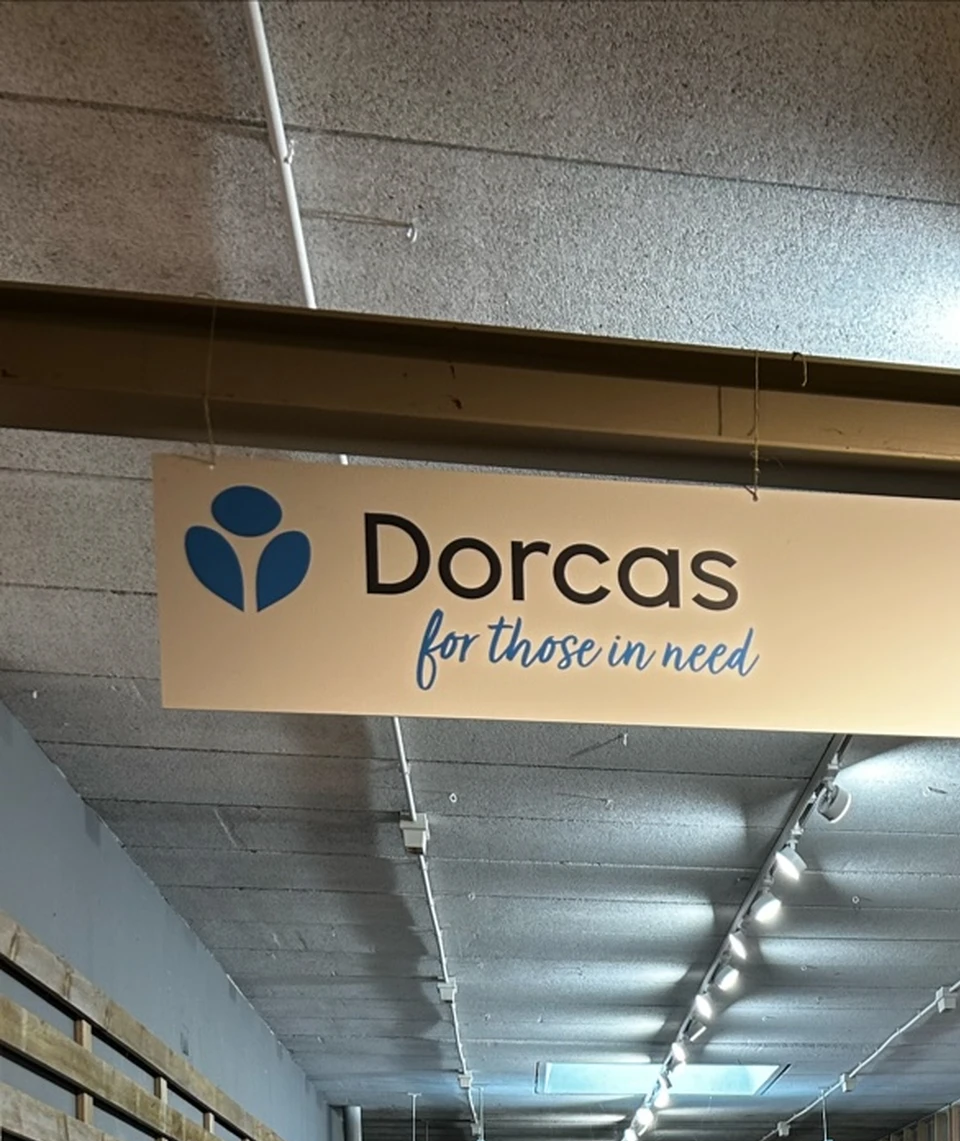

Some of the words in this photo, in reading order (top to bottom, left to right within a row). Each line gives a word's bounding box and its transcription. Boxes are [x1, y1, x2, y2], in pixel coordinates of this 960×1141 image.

[363, 511, 739, 611] Dorcas
[416, 608, 480, 691] for
[487, 615, 602, 671] those
[607, 634, 656, 670] in
[661, 627, 760, 677] need
